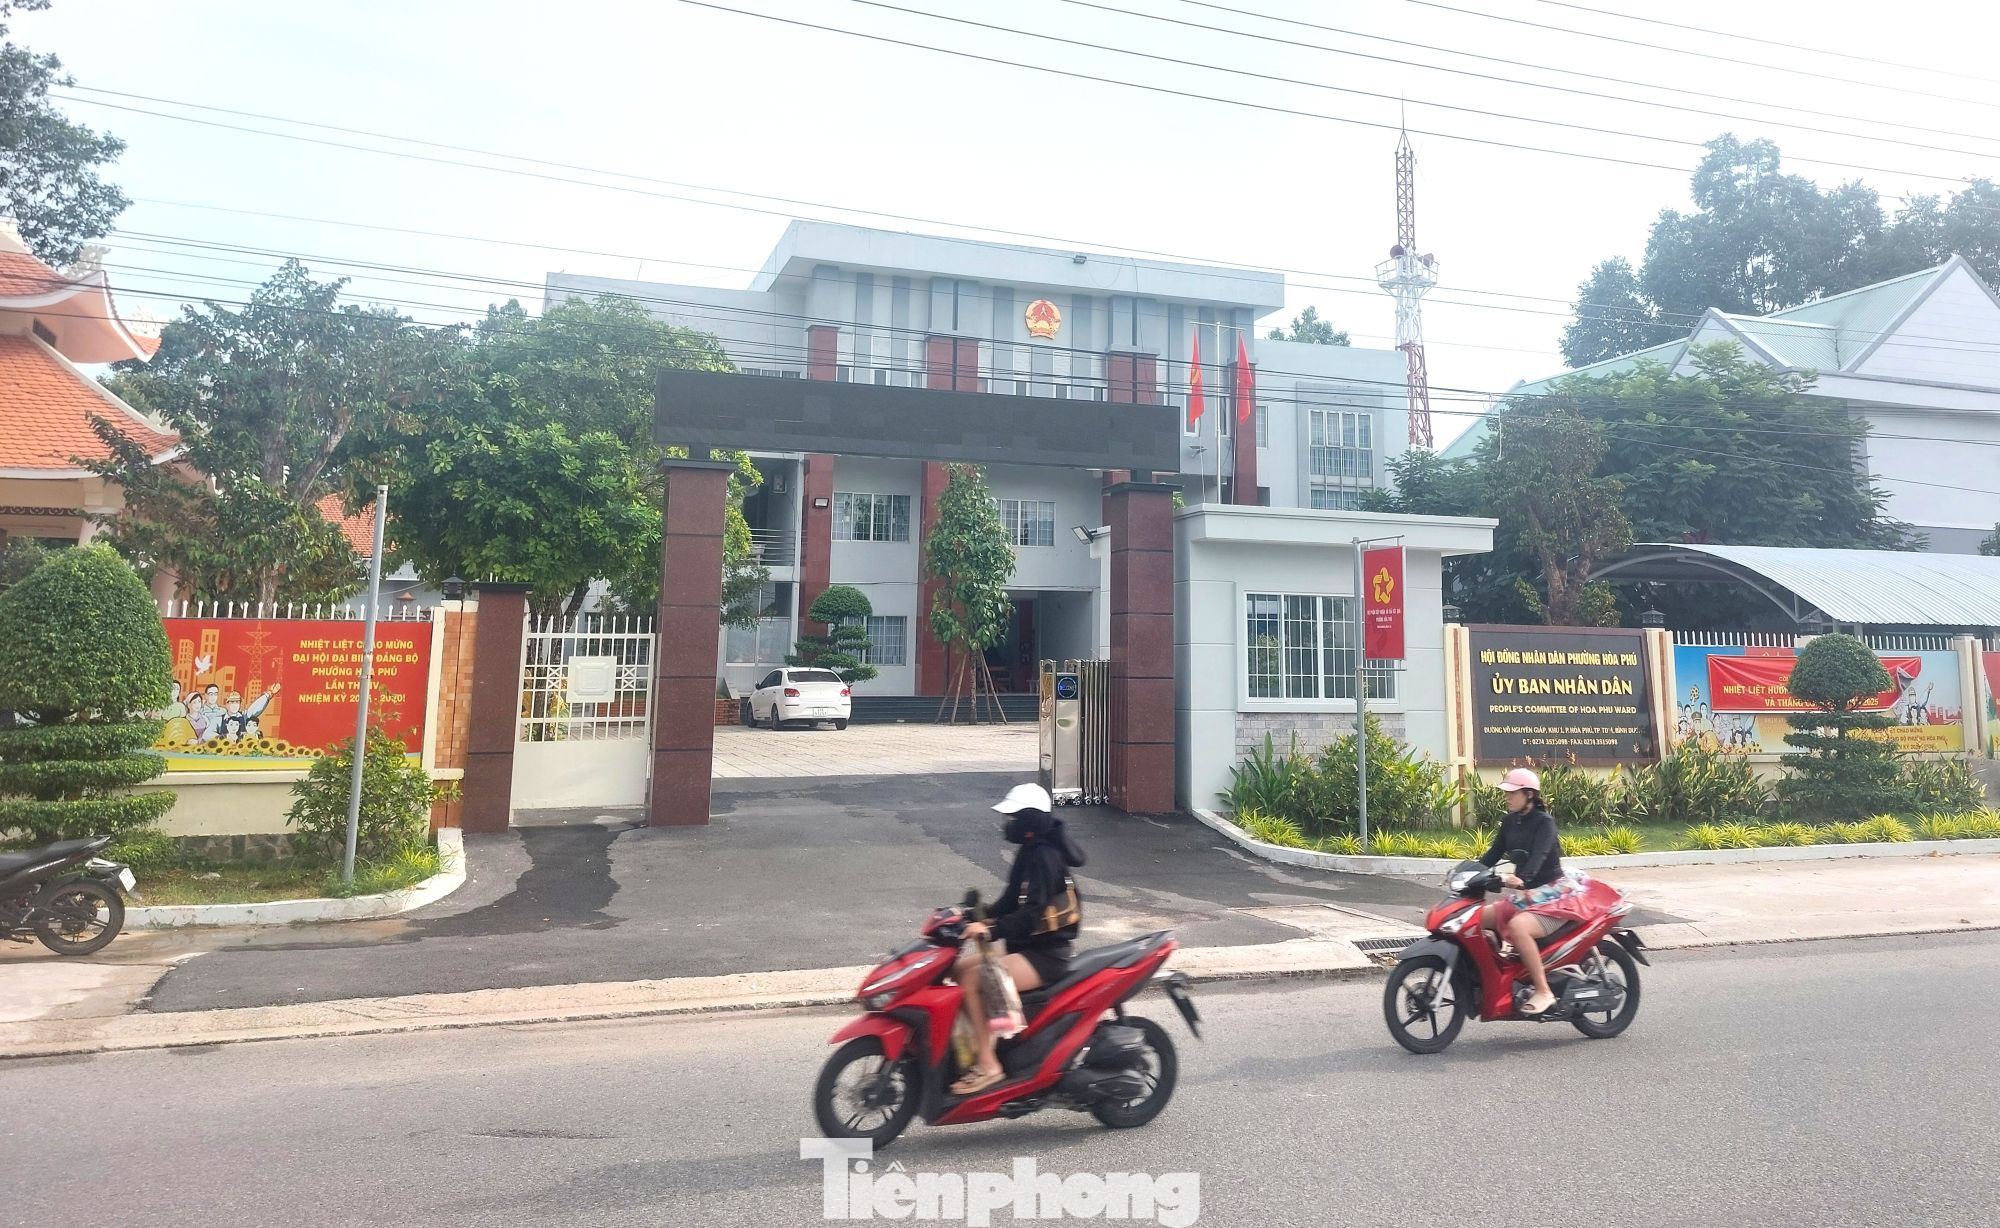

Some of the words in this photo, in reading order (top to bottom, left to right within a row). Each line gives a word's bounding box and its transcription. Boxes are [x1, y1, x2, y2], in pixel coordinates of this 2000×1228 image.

[300, 639, 330, 650] NHIỆT
[333, 639, 354, 650] LIỆT
[1480, 649, 1495, 665] HỘI
[1496, 648, 1520, 663] ĐỒNG
[1548, 650, 1565, 664] DÂN
[1567, 649, 1600, 664] PHƯỜNG
[1602, 650, 1619, 665] HÒA
[1620, 652, 1637, 665] PHÚ
[312, 666, 352, 676] PHƯỜNG
[378, 666, 397, 676] PHÚ
[1492, 672, 1514, 694] ỦY
[1518, 678, 1550, 694] BAN
[1553, 675, 1598, 694] NHÂN
[1601, 675, 1633, 695] DÂN
[299, 693, 330, 704] NHIỆM
[1489, 705, 1523, 714] PEOPLE'S
[1524, 705, 1567, 714] COMMITTEE
[1568, 705, 1579, 713] OF
